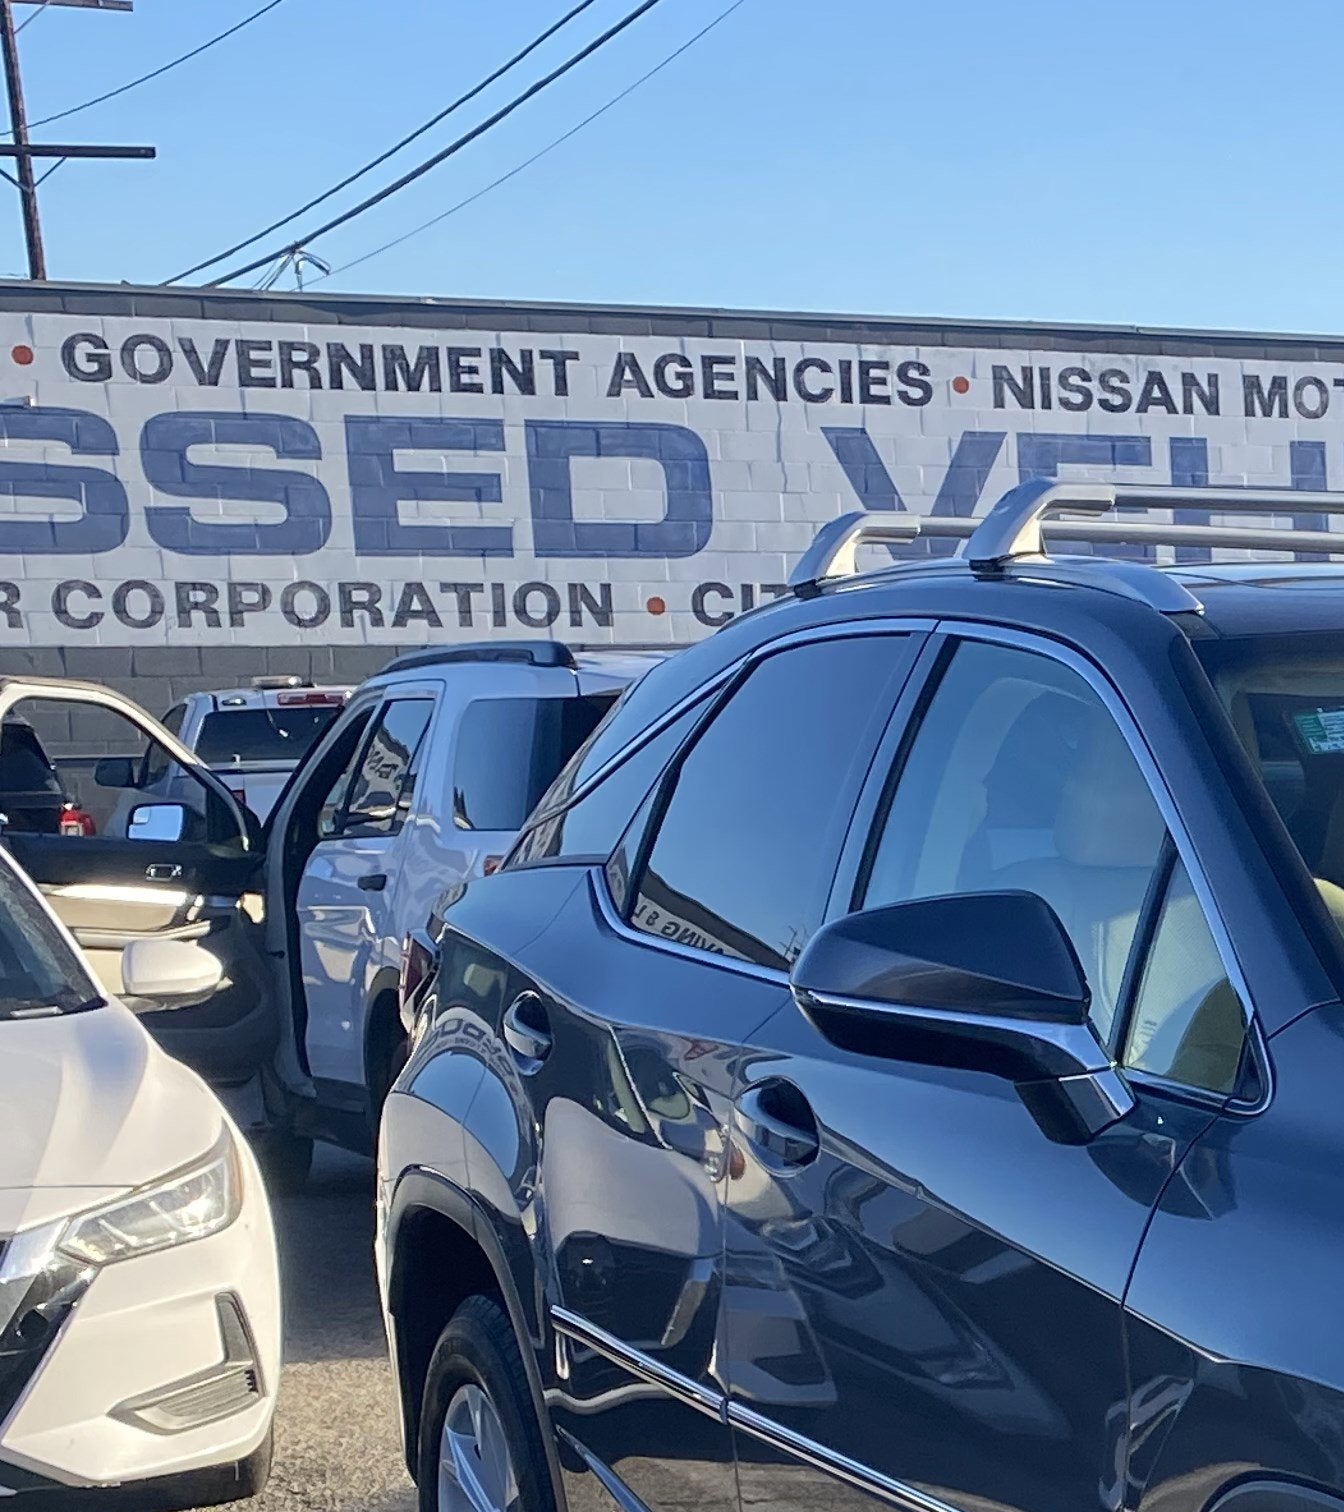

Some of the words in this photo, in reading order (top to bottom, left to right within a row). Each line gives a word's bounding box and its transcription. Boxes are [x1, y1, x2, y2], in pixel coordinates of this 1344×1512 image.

[60, 332, 579, 397] GOVERNMENT
[606, 351, 933, 407] AGENCIES
[991, 364, 1220, 416] NISSAN
[51, 579, 613, 629] CORPORATION
